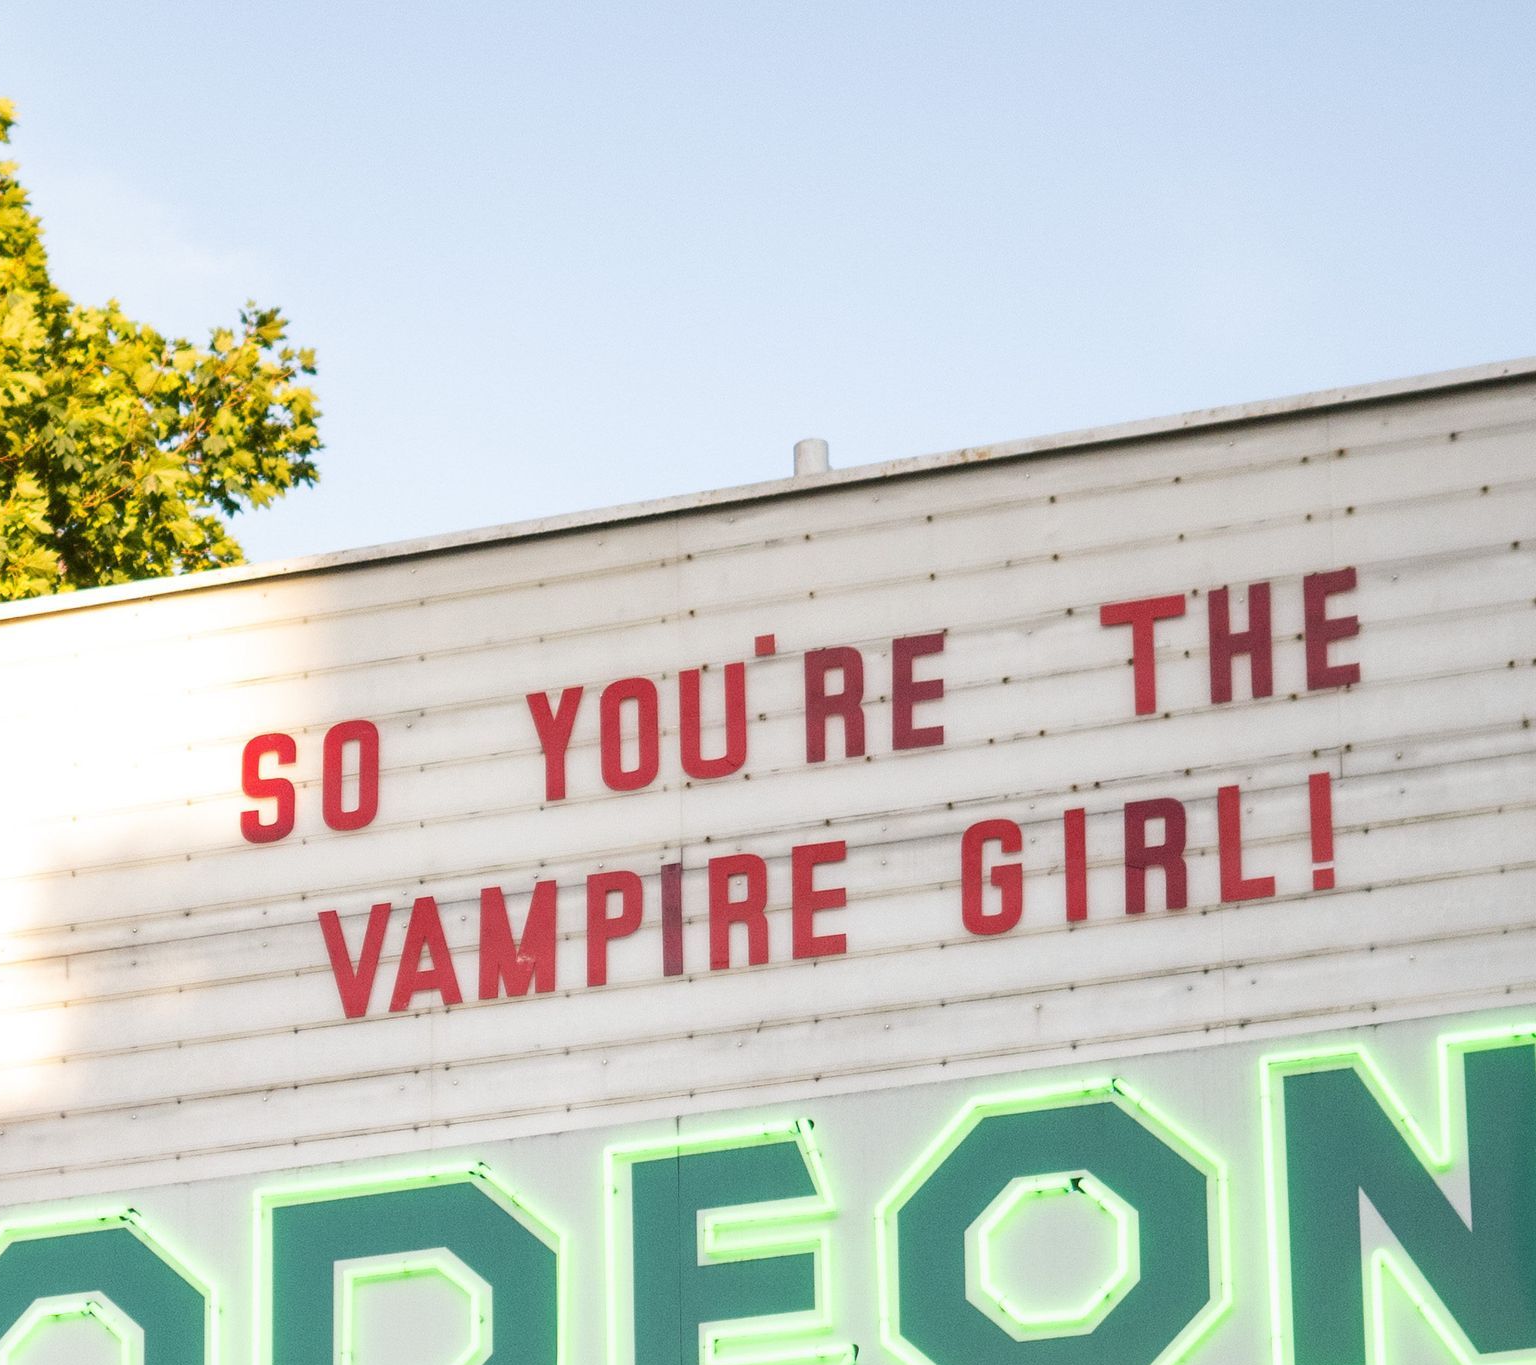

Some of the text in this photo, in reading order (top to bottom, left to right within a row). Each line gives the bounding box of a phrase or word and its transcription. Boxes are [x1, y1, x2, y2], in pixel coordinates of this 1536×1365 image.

[239, 569, 1360, 845] SO YOU'RE THE
[318, 771, 1336, 1020] VAMPIRE GIRL!
